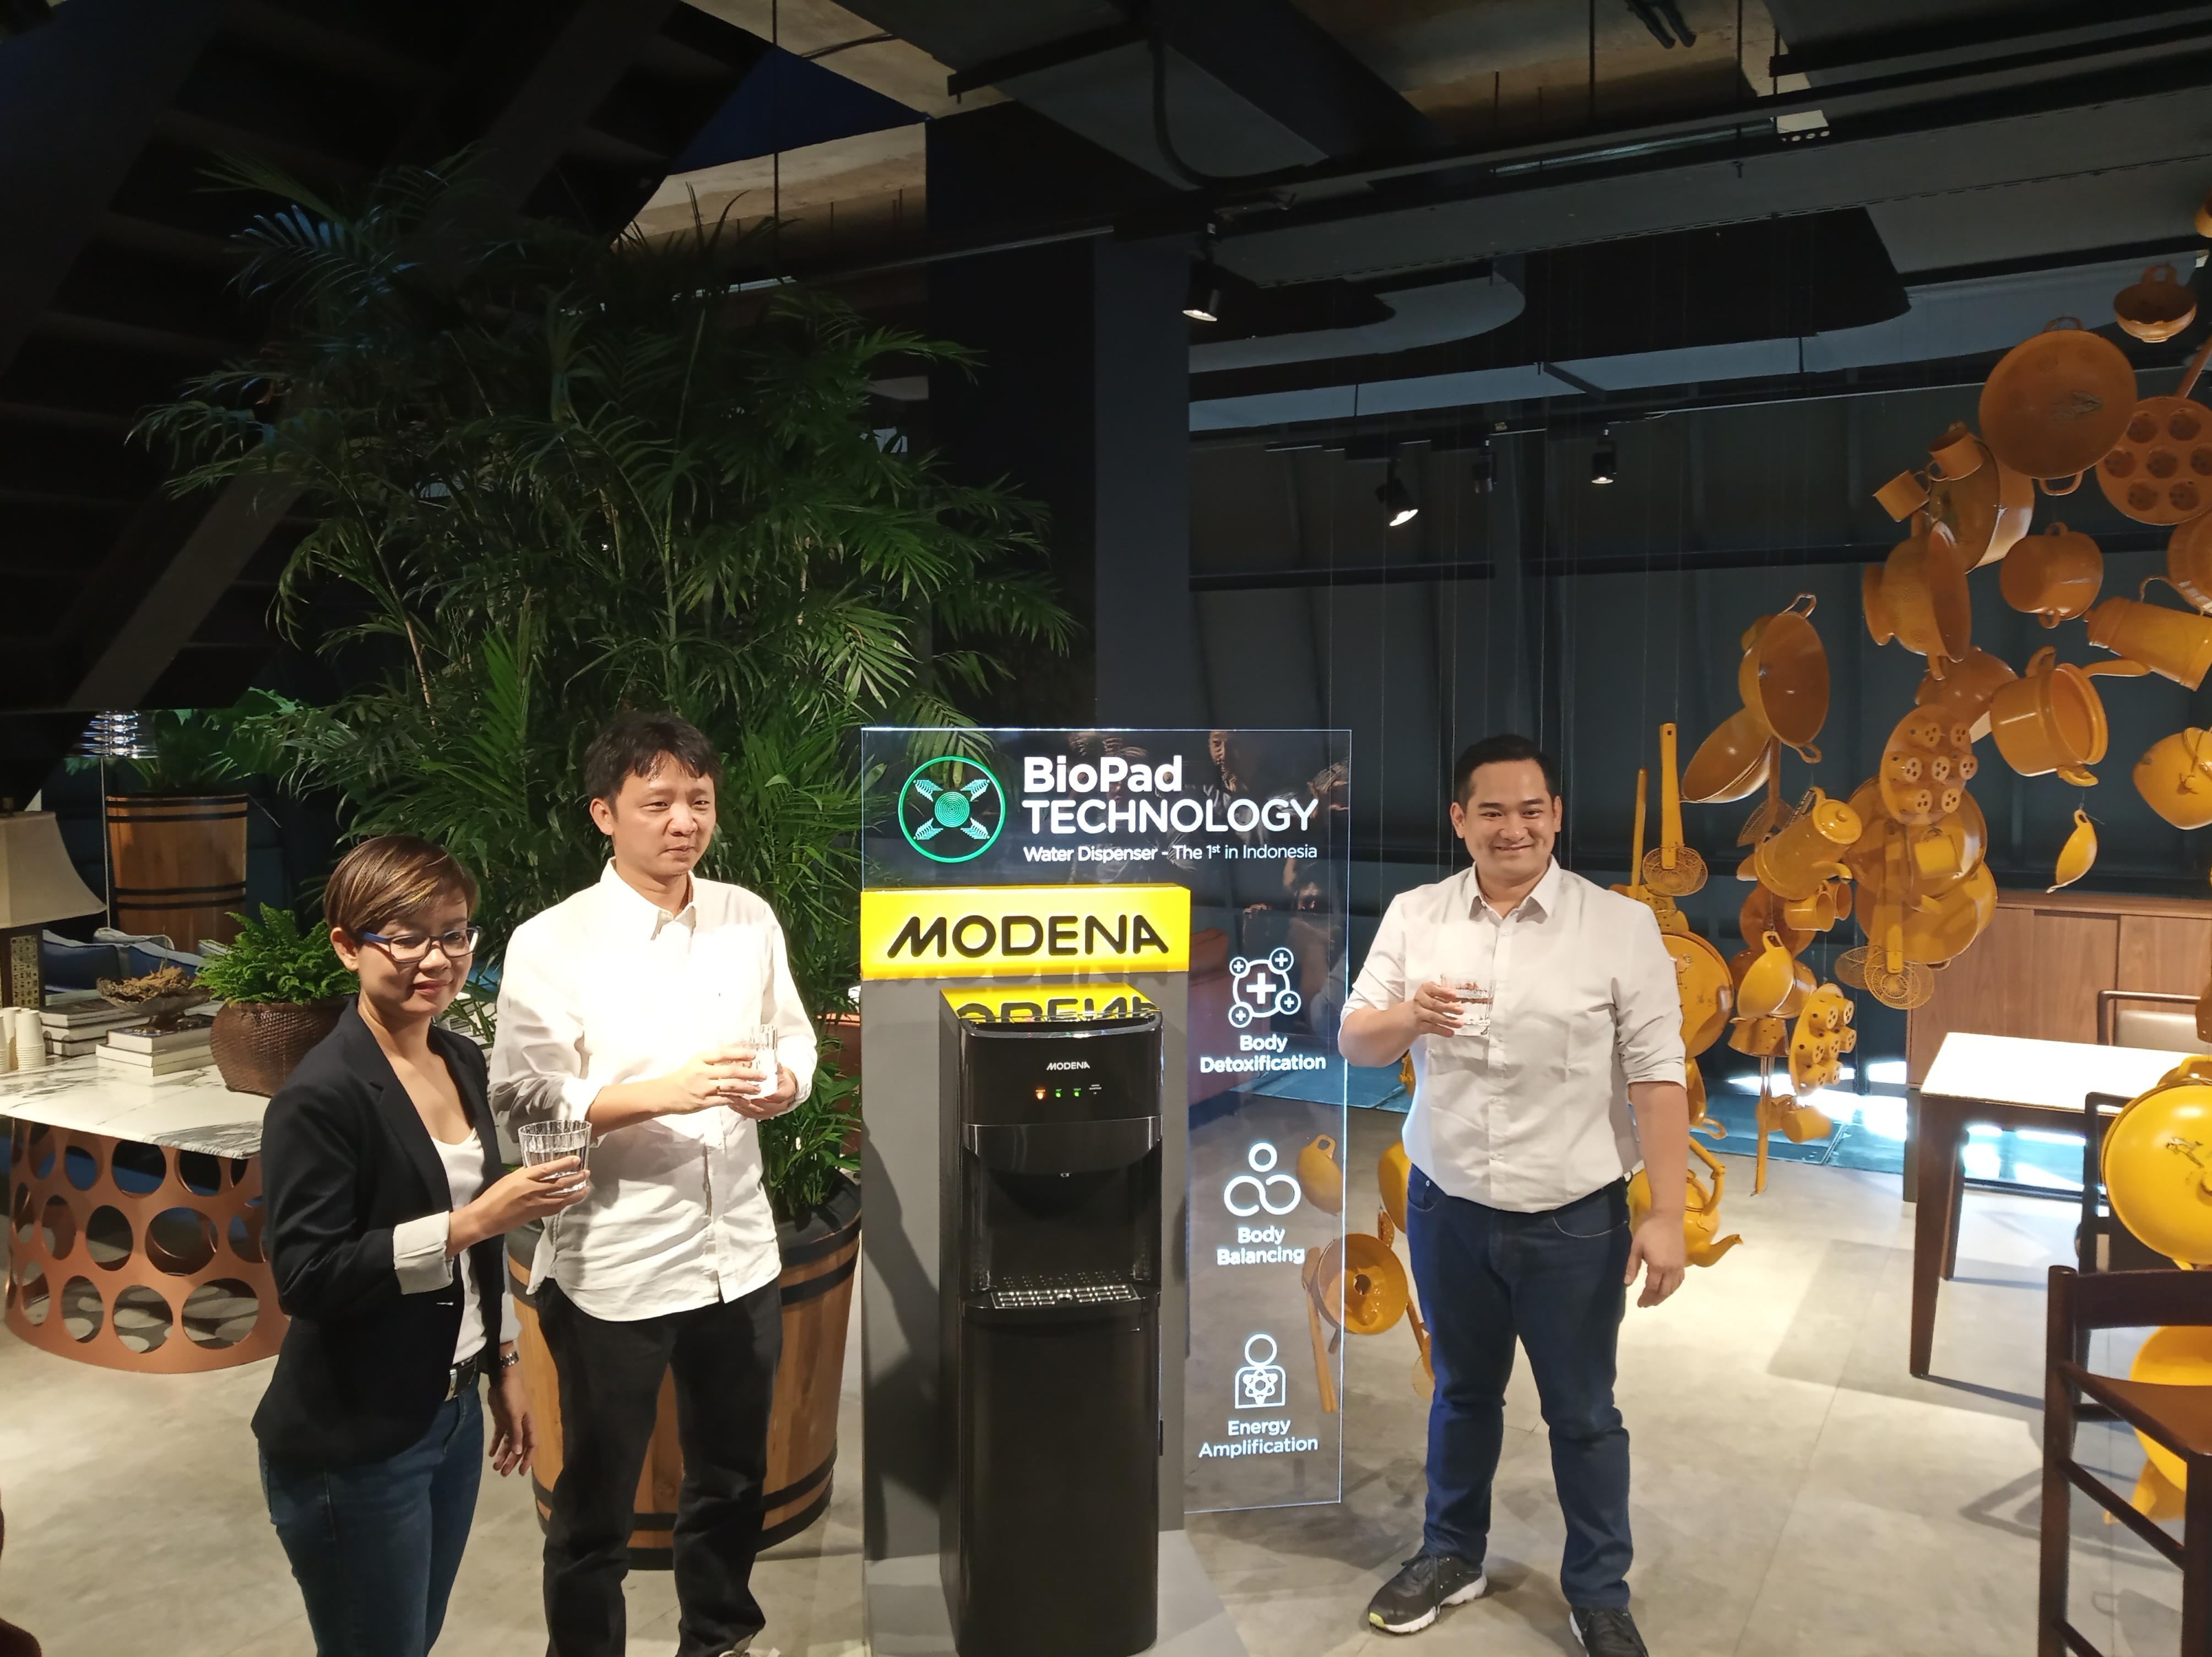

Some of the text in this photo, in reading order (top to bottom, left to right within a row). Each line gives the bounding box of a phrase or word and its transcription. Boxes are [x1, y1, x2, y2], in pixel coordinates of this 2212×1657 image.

[1023, 755, 1183, 793] BioPad
[1022, 798, 1319, 834] TECHNOLOGY
[1023, 846, 1075, 862] Water
[1078, 845, 1159, 863] Dispenser
[1173, 844, 1203, 860] The
[1206, 844, 1221, 859] 1st
[1225, 844, 1238, 859] in
[1243, 844, 1317, 859] Indonesia
[887, 914, 1169, 958] MODENA
[1239, 1034, 1288, 1053] Body
[1046, 1061, 1091, 1071] MODENA
[1200, 1054, 1326, 1073] Detoxification
[1238, 1226, 1286, 1244] Body
[1217, 1246, 1305, 1265] Balancing
[1228, 1420, 1291, 1436] Energy
[1198, 1437, 1318, 1458] Amplification
